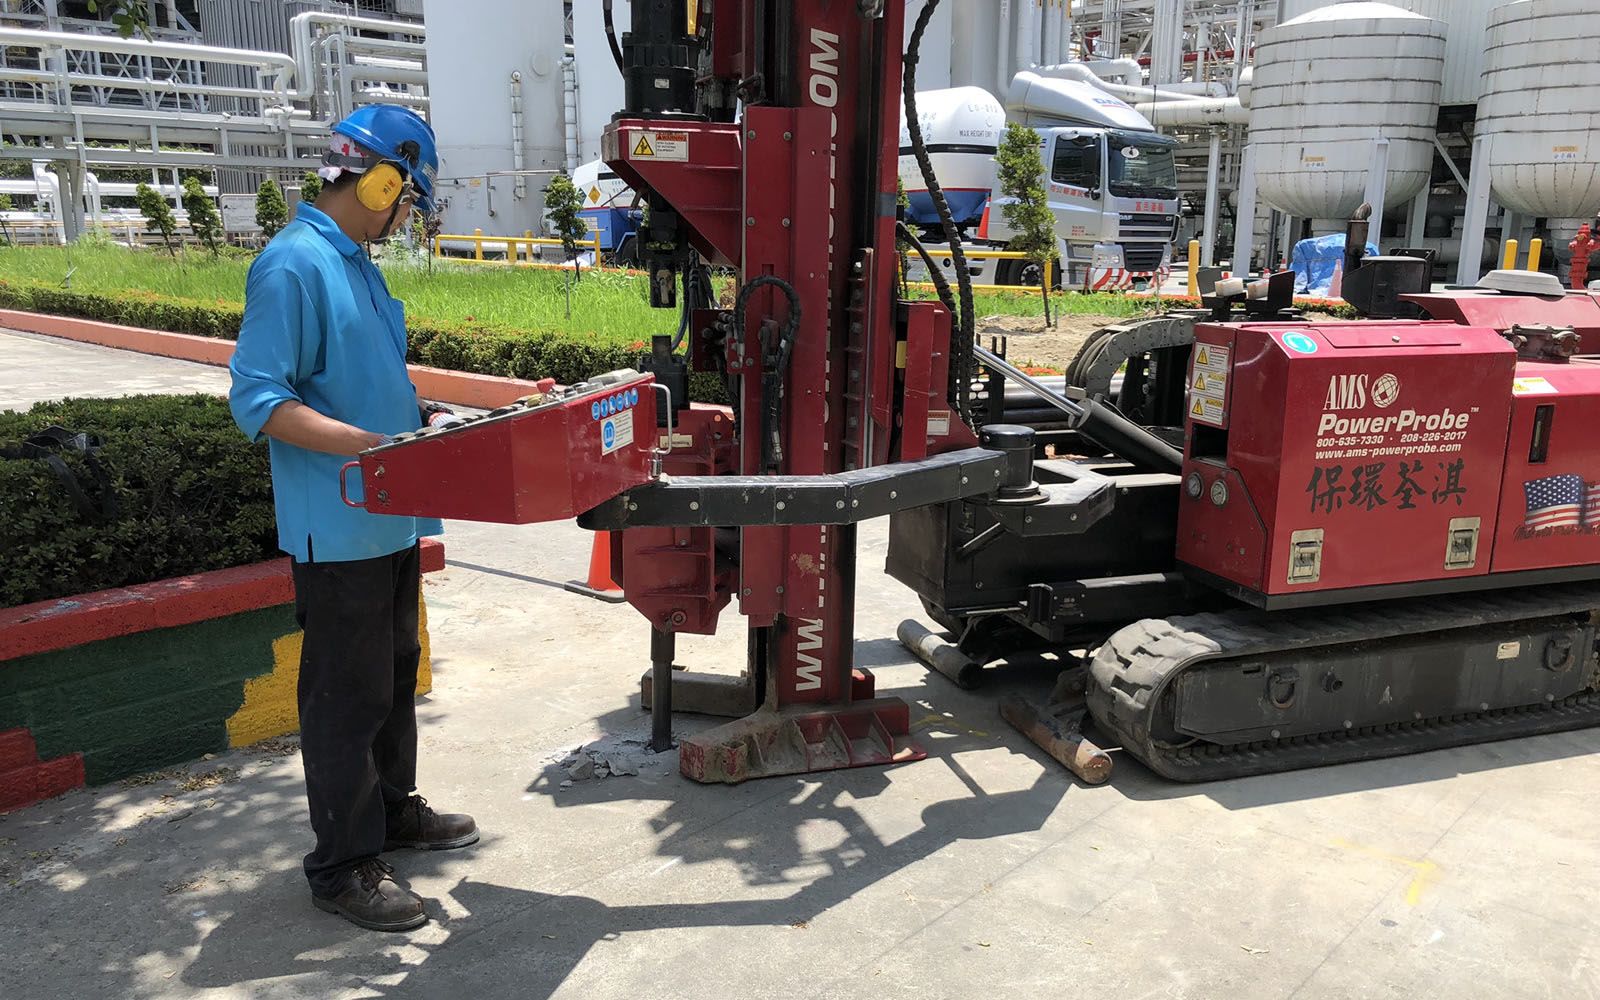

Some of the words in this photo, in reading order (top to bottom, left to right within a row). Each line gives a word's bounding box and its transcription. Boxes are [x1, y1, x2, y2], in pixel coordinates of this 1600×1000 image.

[1322, 373, 1369, 411] AMS
[1316, 408, 1470, 436] PowerProbe
[1316, 435, 1384, 448] 800-635-7330
[1400, 431, 1467, 443] 208-226-2017
[1315, 443, 1462, 460] www.ams-powerprobe.com
